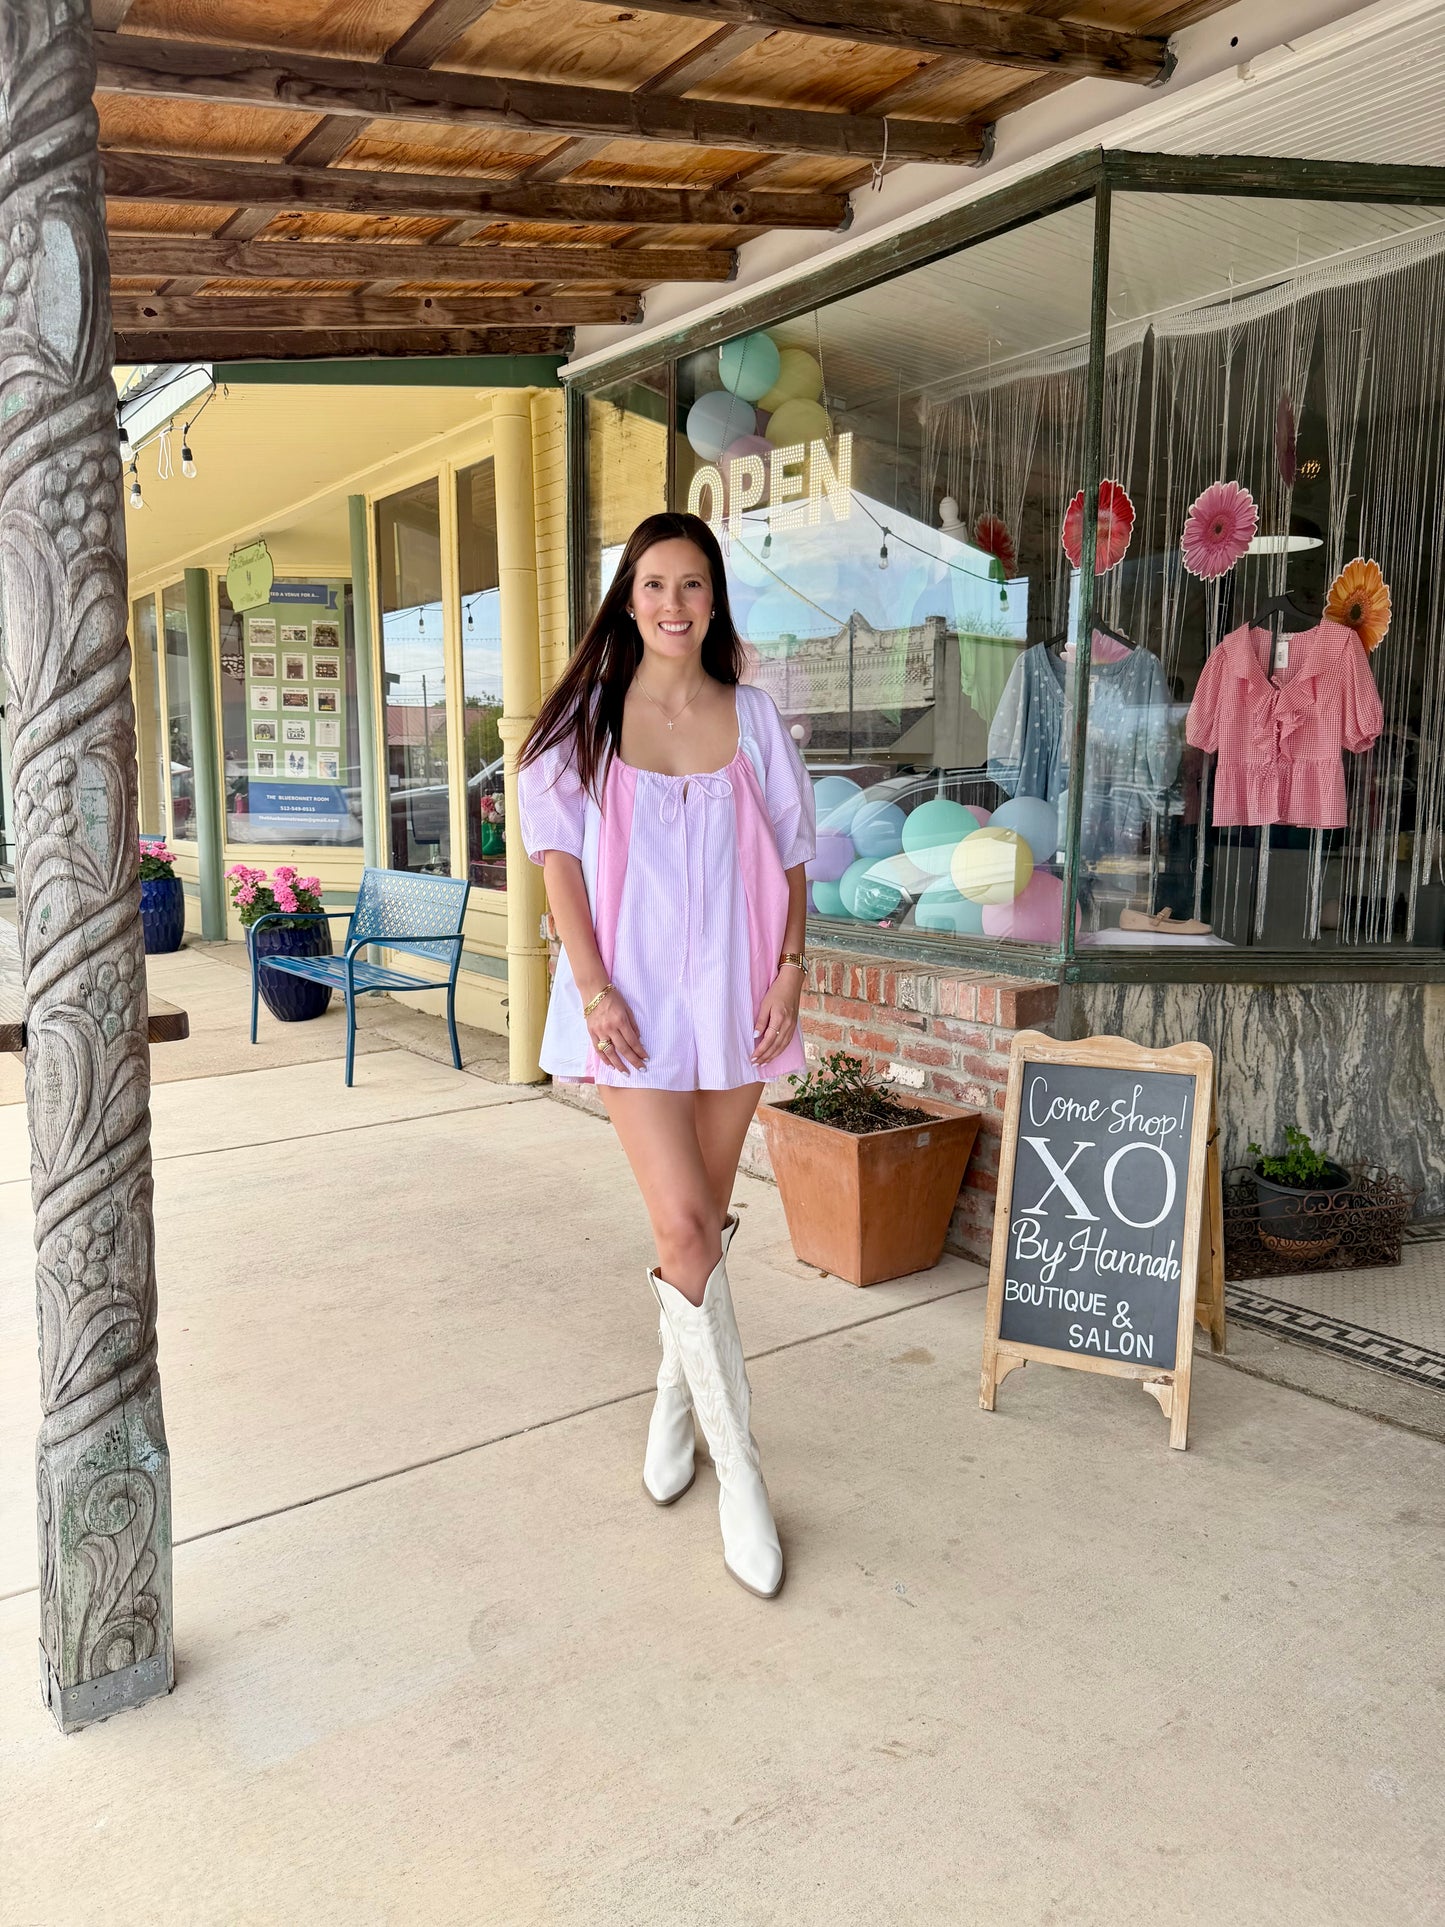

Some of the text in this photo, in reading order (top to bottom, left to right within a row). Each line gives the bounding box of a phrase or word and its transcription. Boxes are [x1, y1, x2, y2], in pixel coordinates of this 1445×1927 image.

[687, 431, 853, 541] OPEN
[1029, 1076, 1109, 1128] Come
[1020, 1136, 1177, 1229] XO
[1011, 1217, 1181, 1284] By Hannah
[1005, 1279, 1133, 1331] BOUTIQUE &
[1068, 1324, 1154, 1360] SALON
